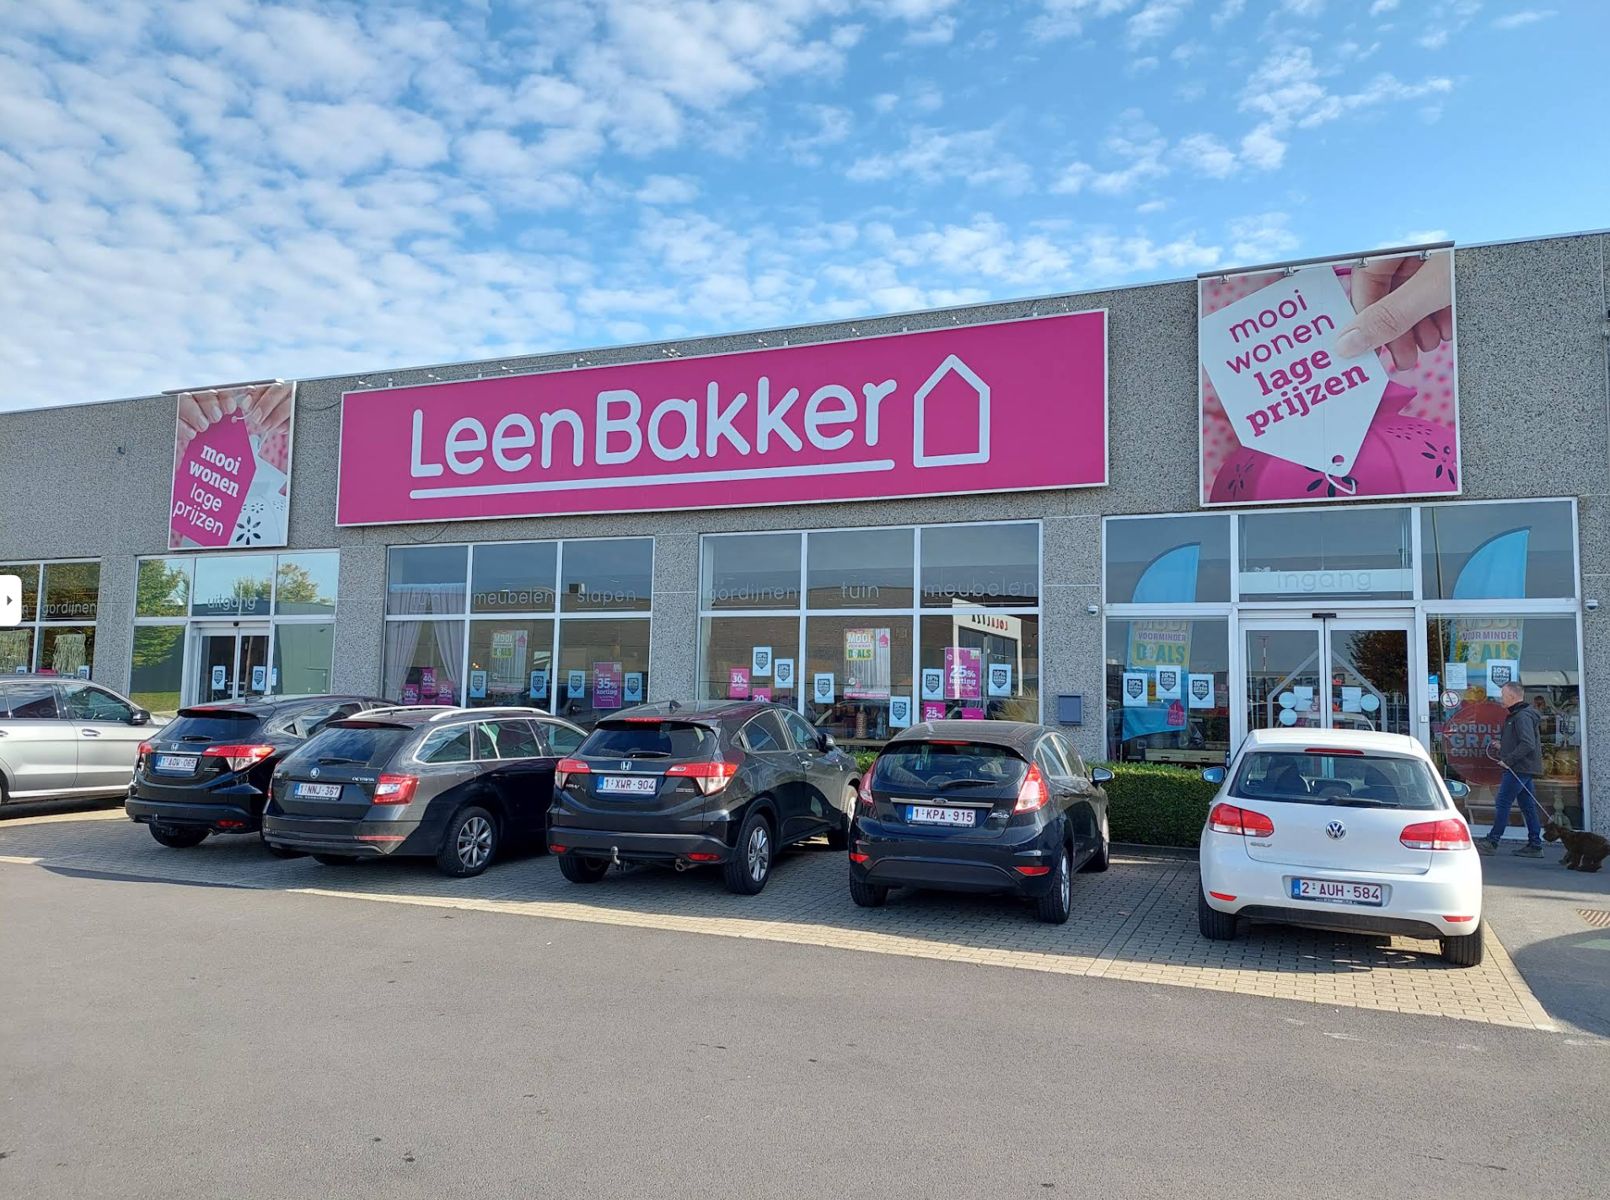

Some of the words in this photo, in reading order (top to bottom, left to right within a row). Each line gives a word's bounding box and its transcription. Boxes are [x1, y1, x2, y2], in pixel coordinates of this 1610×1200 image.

[1229, 289, 1307, 343] mooi
[1226, 314, 1335, 374] wonen
[1254, 350, 1331, 396] lage
[1246, 365, 1370, 437] prijzen
[200, 444, 242, 475] mooi
[189, 460, 240, 498] wonen
[190, 482, 222, 512] lage
[173, 499, 224, 536] prijzen
[841, 581, 880, 599] tuin
[924, 576, 1036, 597] meubelen
[1277, 570, 1372, 591] ingang
[473, 588, 555, 605] meubelen
[577, 587, 637, 606] slapen
[710, 581, 798, 603] gordijnen
[42, 600, 97, 616] gordijnen
[1483, 630, 1519, 640] MINDER
[950, 665, 976, 677] 25%
[597, 677, 618, 689] 35%
[1451, 723, 1501, 734] GORDIJ
[605, 777, 654, 790] 1-XWR-904
[914, 808, 973, 823] 1-KPA-915
[1302, 882, 1379, 900] 2-AUH-584
